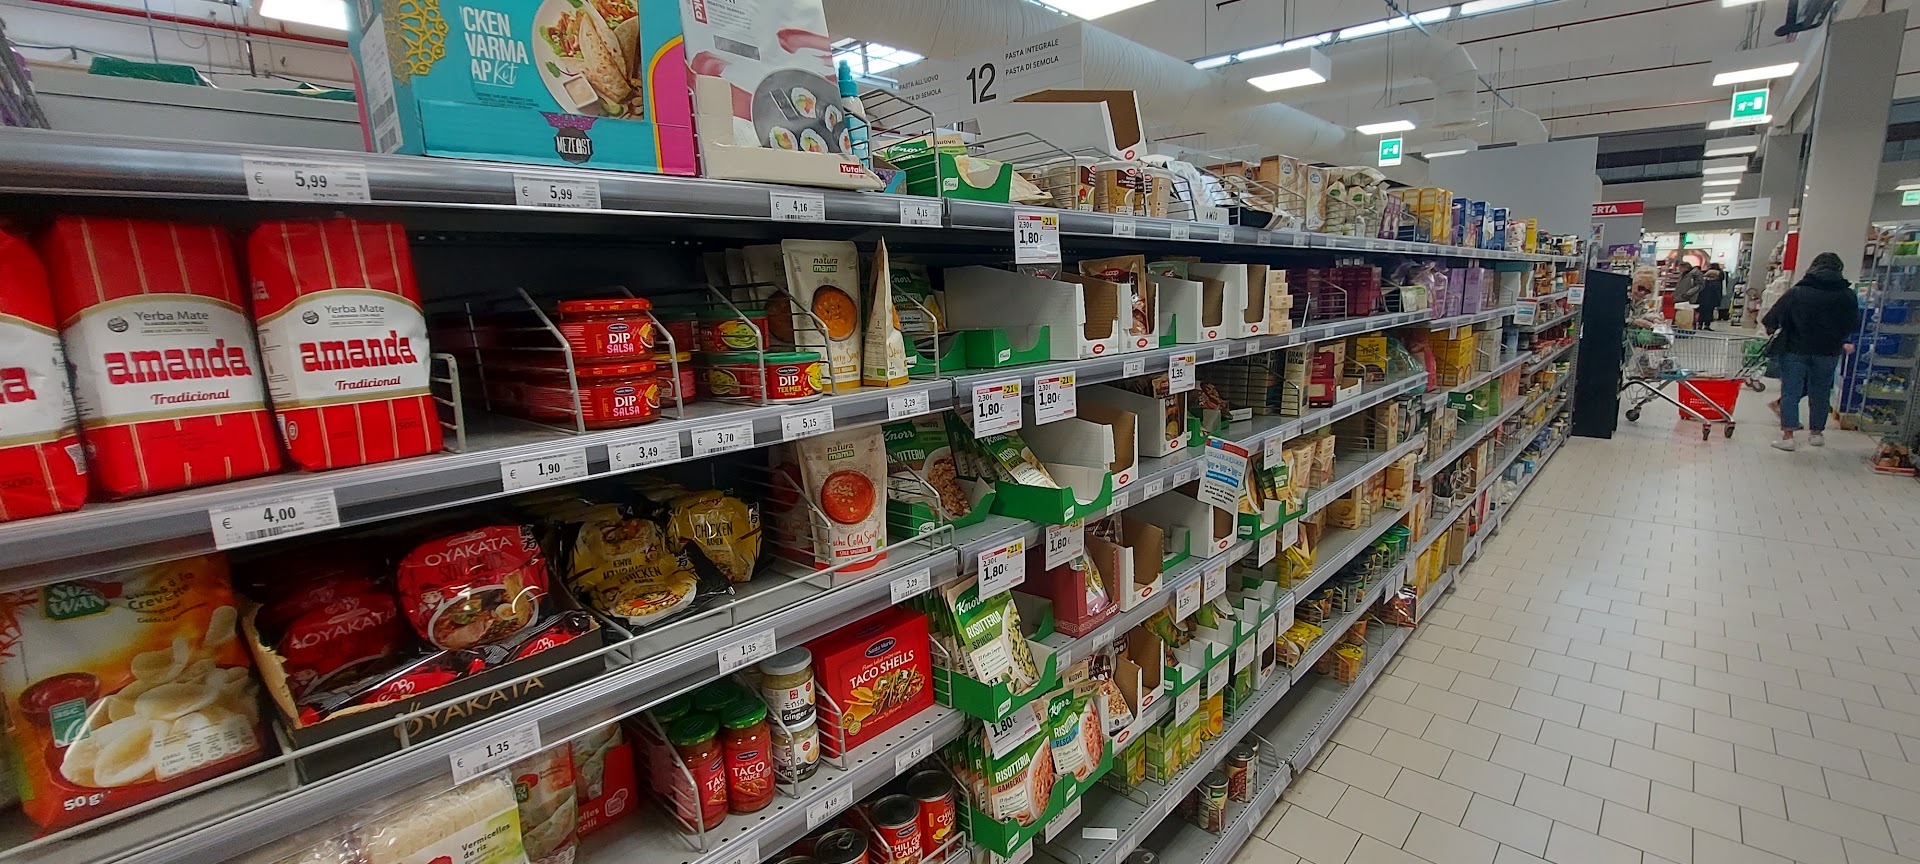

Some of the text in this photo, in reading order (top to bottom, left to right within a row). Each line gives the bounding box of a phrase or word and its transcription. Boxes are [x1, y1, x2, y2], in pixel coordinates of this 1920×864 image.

[1005, 38, 1059, 60] PASTA INTEGRALE
[493, 59, 519, 85] Kit
[1005, 55, 1059, 76] PASTA DI SEMOLA
[915, 74, 939, 88] ALL'UOVO
[966, 62, 997, 105] 12
[915, 92, 921, 100] DI
[922, 88, 942, 99] SEMOLA
[556, 137, 592, 156] MEZEAST
[254, 170, 328, 191] € 5,99
[549, 184, 573, 202] 5,99
[793, 199, 808, 214] 4,16
[916, 206, 928, 218] 4,15
[1714, 204, 1730, 217] 13
[813, 256, 838, 265] natura
[134, 310, 209, 321] Yerba Mate
[324, 304, 385, 314] Yerba Mate
[608, 332, 632, 344] DIP
[299, 329, 418, 373] amanda
[606, 343, 635, 354] SALSA
[104, 338, 253, 385] amanda
[334, 376, 401, 391] Tradicional
[778, 375, 799, 387] DIP
[150, 389, 230, 406] Tradicional
[614, 395, 637, 408] DIP
[903, 398, 916, 408] 3,29
[612, 406, 640, 417] SALSA
[802, 417, 817, 430] 5,15
[717, 432, 735, 445] 3,70
[638, 446, 659, 460] 3,49
[827, 442, 854, 453] natura
[509, 462, 561, 480] € 1,90
[222, 504, 297, 530] € 4,00
[695, 521, 733, 539] CHICKEN
[847, 533, 864, 547] Cold
[424, 536, 513, 567] OYAKATA
[906, 578, 918, 589] 3,29
[965, 612, 1003, 640] RISOTTERIA
[740, 643, 757, 656] 1,35
[880, 649, 914, 674] SHELLS
[849, 665, 879, 689] TACO
[393, 676, 545, 739] OYAKATA
[783, 709, 808, 722] Ginger
[485, 740, 510, 758] 1,35
[732, 761, 765, 777] TACO
[995, 751, 1031, 784] RISOTTERIA
[739, 773, 761, 782] SAUCE
[63, 795, 86, 812] 50
[824, 797, 838, 811] 4,49
[461, 823, 511, 851] Vermicelles
[463, 850, 475, 860] de
[477, 844, 487, 854] riz
